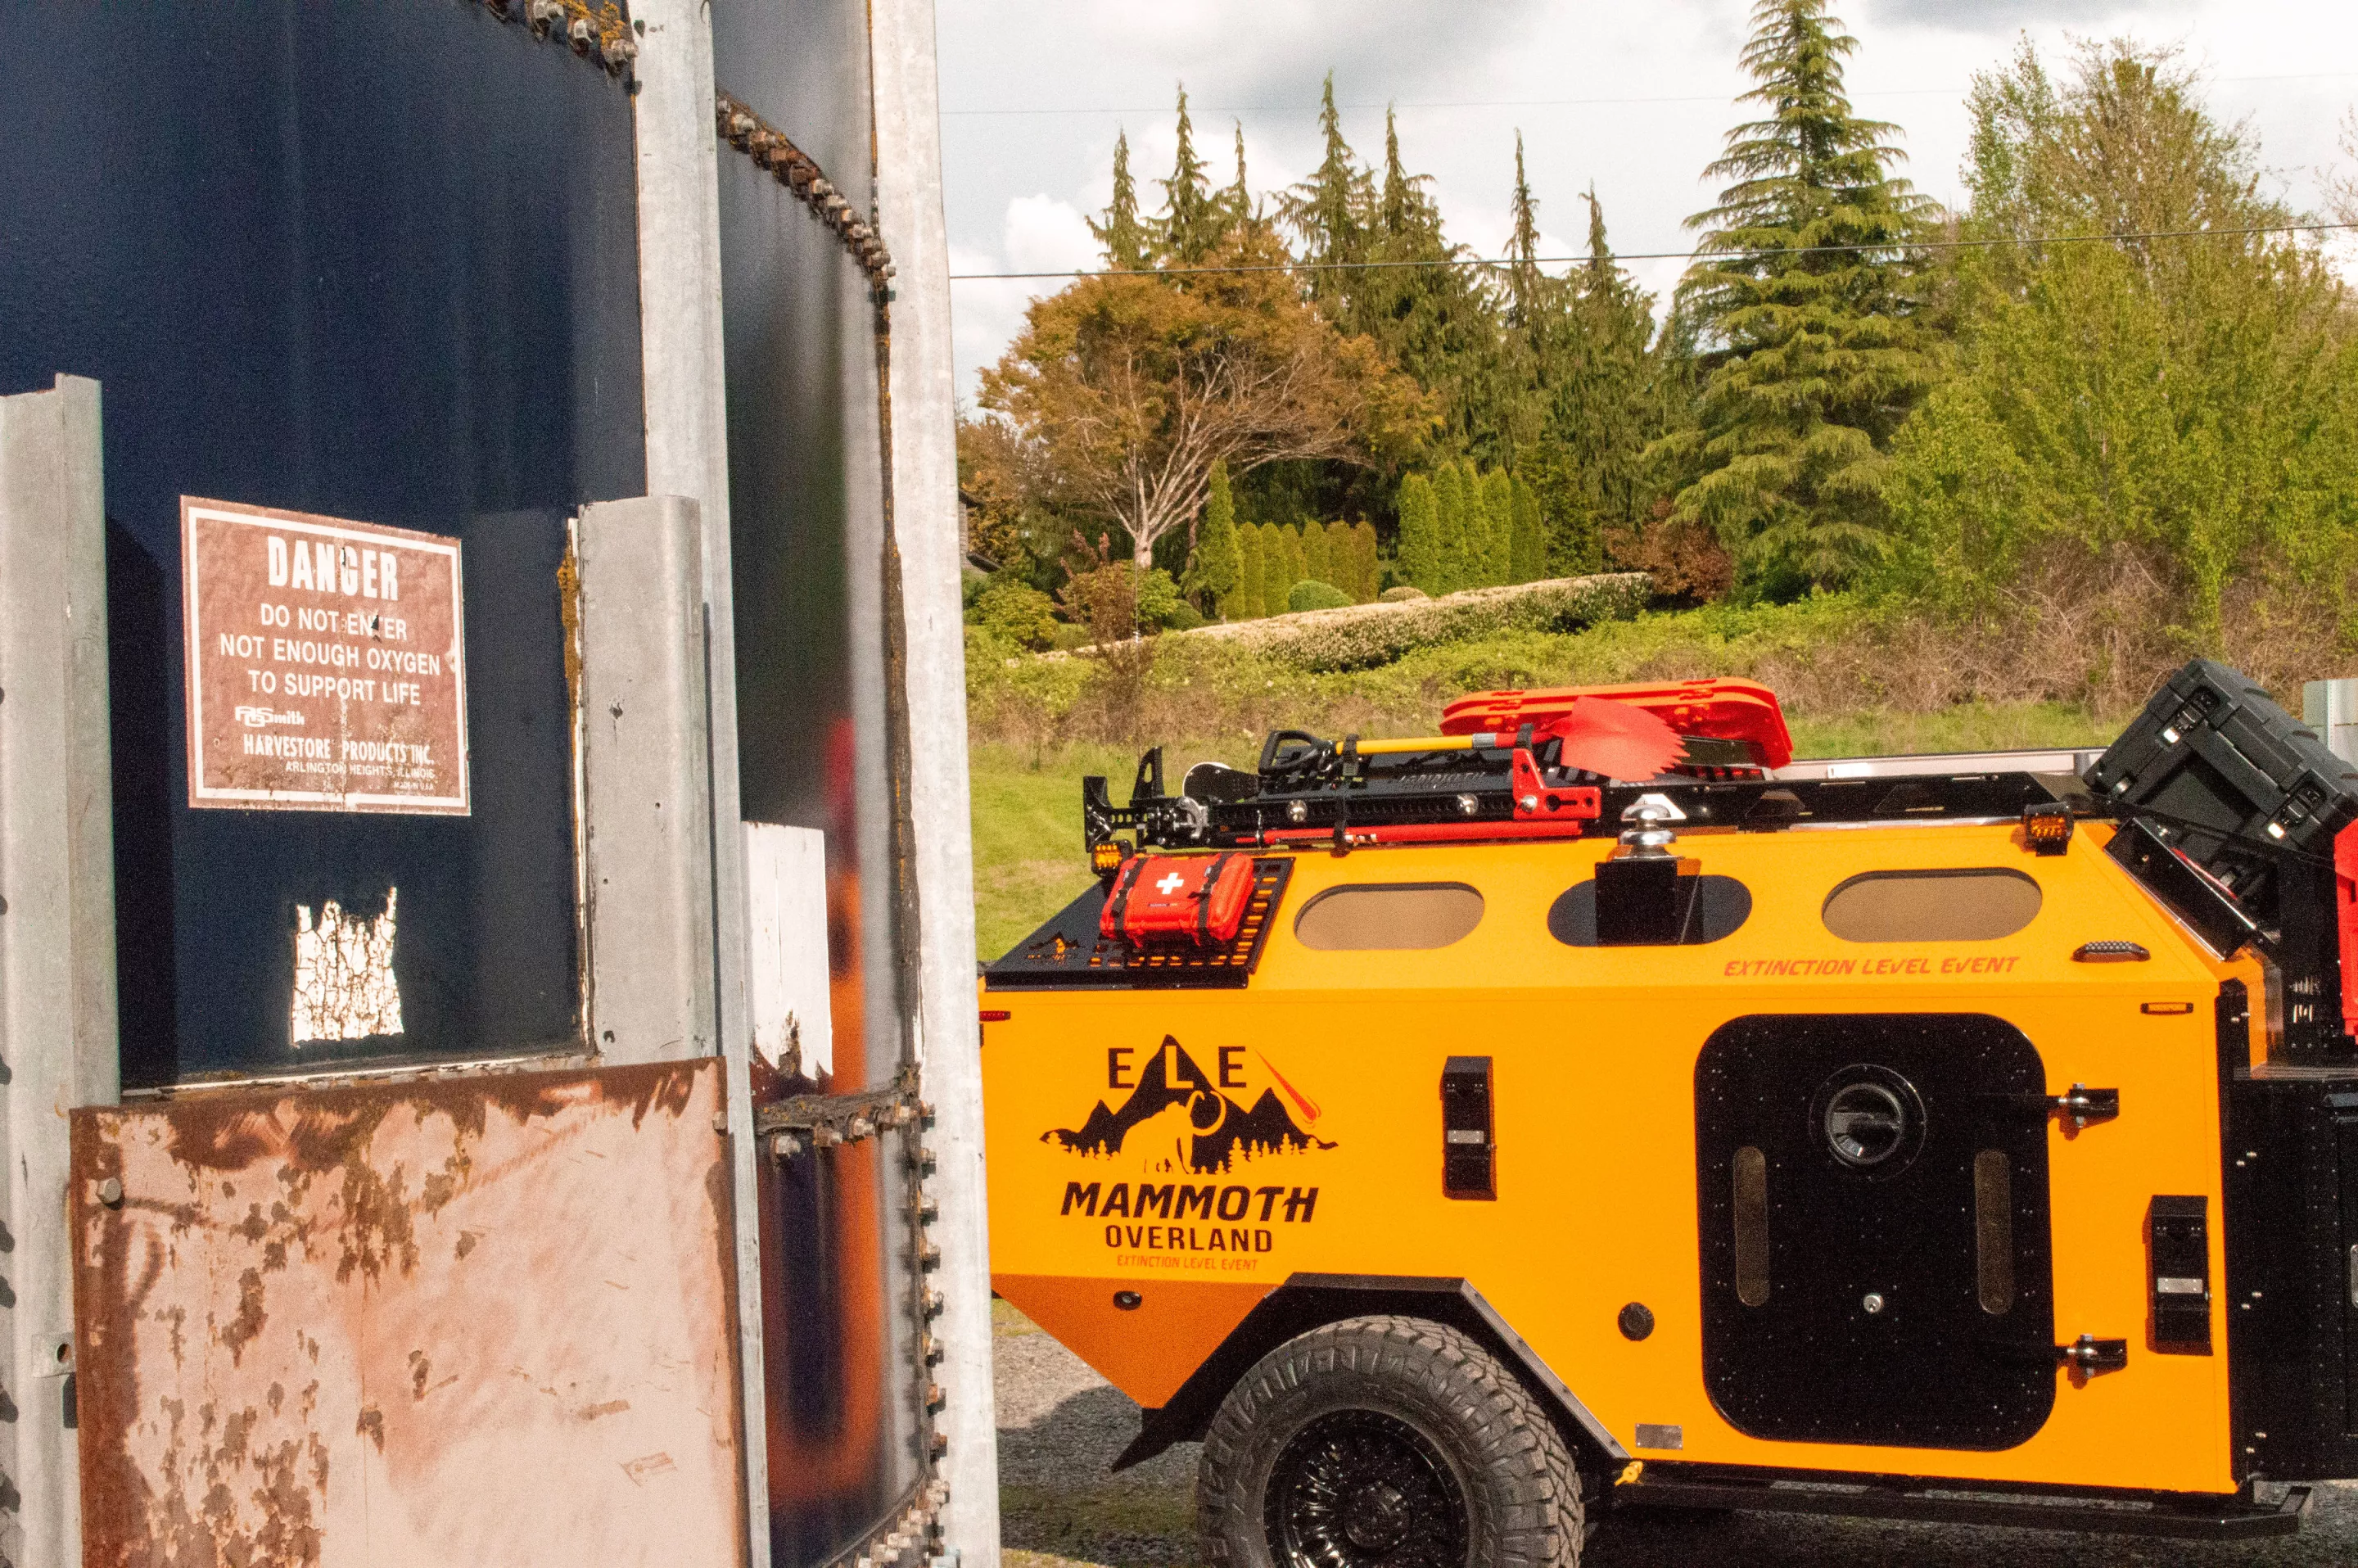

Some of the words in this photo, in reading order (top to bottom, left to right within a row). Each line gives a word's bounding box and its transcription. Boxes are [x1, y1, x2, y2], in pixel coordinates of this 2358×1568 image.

[268, 536, 399, 601] DANGER
[260, 603, 290, 627] DO
[299, 608, 339, 632] NOT
[220, 633, 264, 657] NOT
[273, 639, 359, 668] ENOUGH
[367, 648, 440, 676] OXYGEN
[248, 670, 276, 694] TO
[284, 673, 376, 702] SUPPORT
[382, 684, 421, 706] LIFE
[243, 734, 331, 760] HARVESTORE
[342, 741, 407, 763] PRODUCTS
[285, 761, 347, 775] ARLINGTON
[1723, 958, 1858, 977] EXTINCTION
[1861, 957, 1931, 976] LEVEL
[1940, 956, 2021, 974] EVENT
[1060, 1181, 1320, 1223] MAMMOTH
[1105, 1224, 1273, 1253] OVERLAND
[1117, 1254, 1180, 1268] EXTINCTION
[1183, 1256, 1217, 1269] LEVEL
[1221, 1258, 1258, 1272] EVENT
